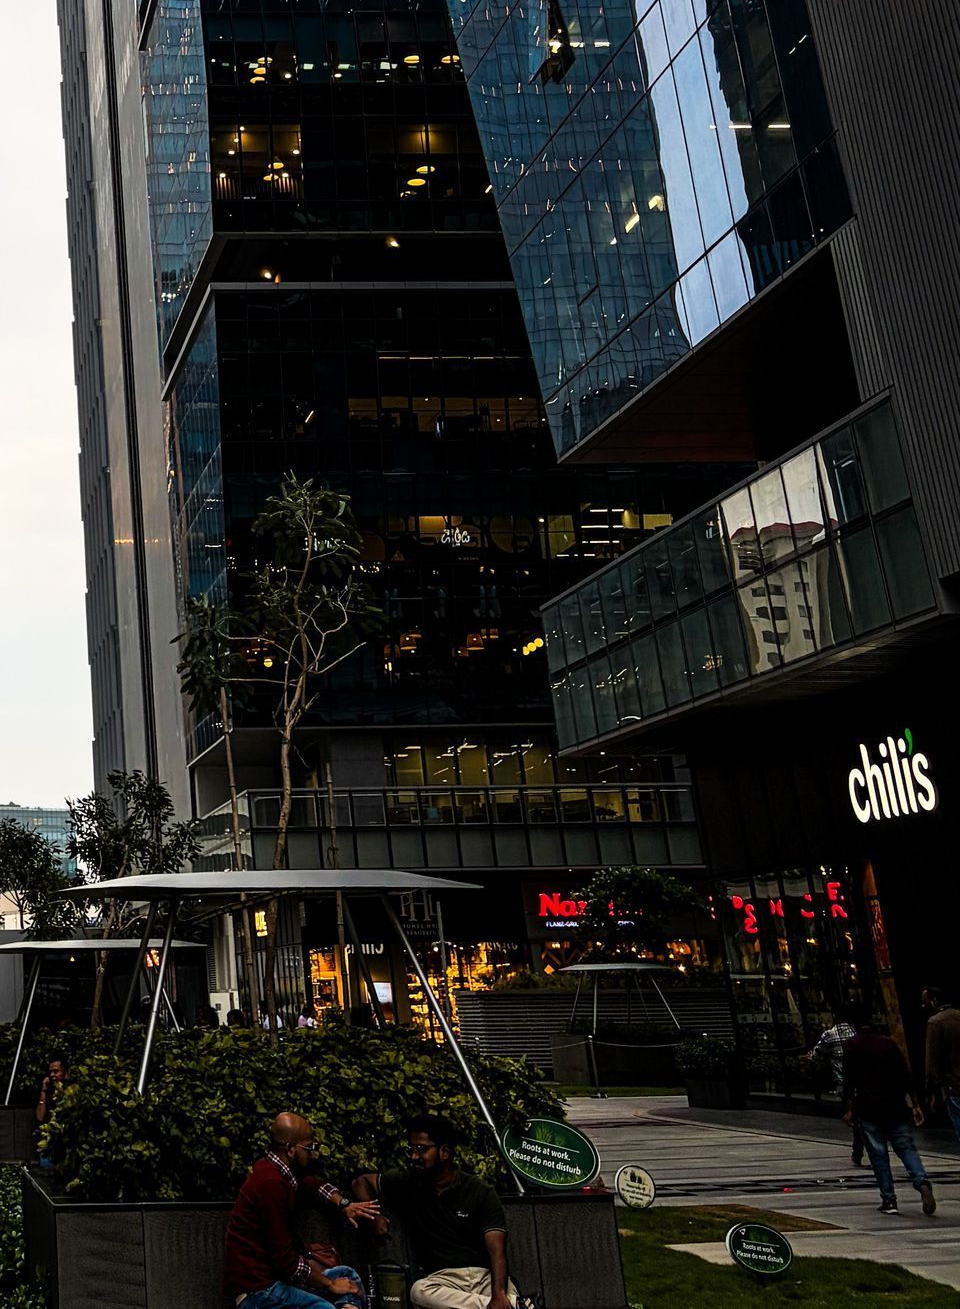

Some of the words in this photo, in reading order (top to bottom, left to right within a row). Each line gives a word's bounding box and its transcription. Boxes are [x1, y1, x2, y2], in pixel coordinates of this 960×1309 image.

[521, 1140, 541, 1153] Roots
[542, 1147, 550, 1156] at
[551, 1150, 571, 1161] work.
[509, 1148, 531, 1162] Please
[532, 1155, 541, 1165] do
[542, 1159, 555, 1169] not
[556, 1161, 581, 1175] disturb
[742, 1242, 757, 1251] Roots
[736, 1249, 751, 1258] Please
[751, 1252, 758, 1260] do
[767, 1255, 784, 1264] disturb
